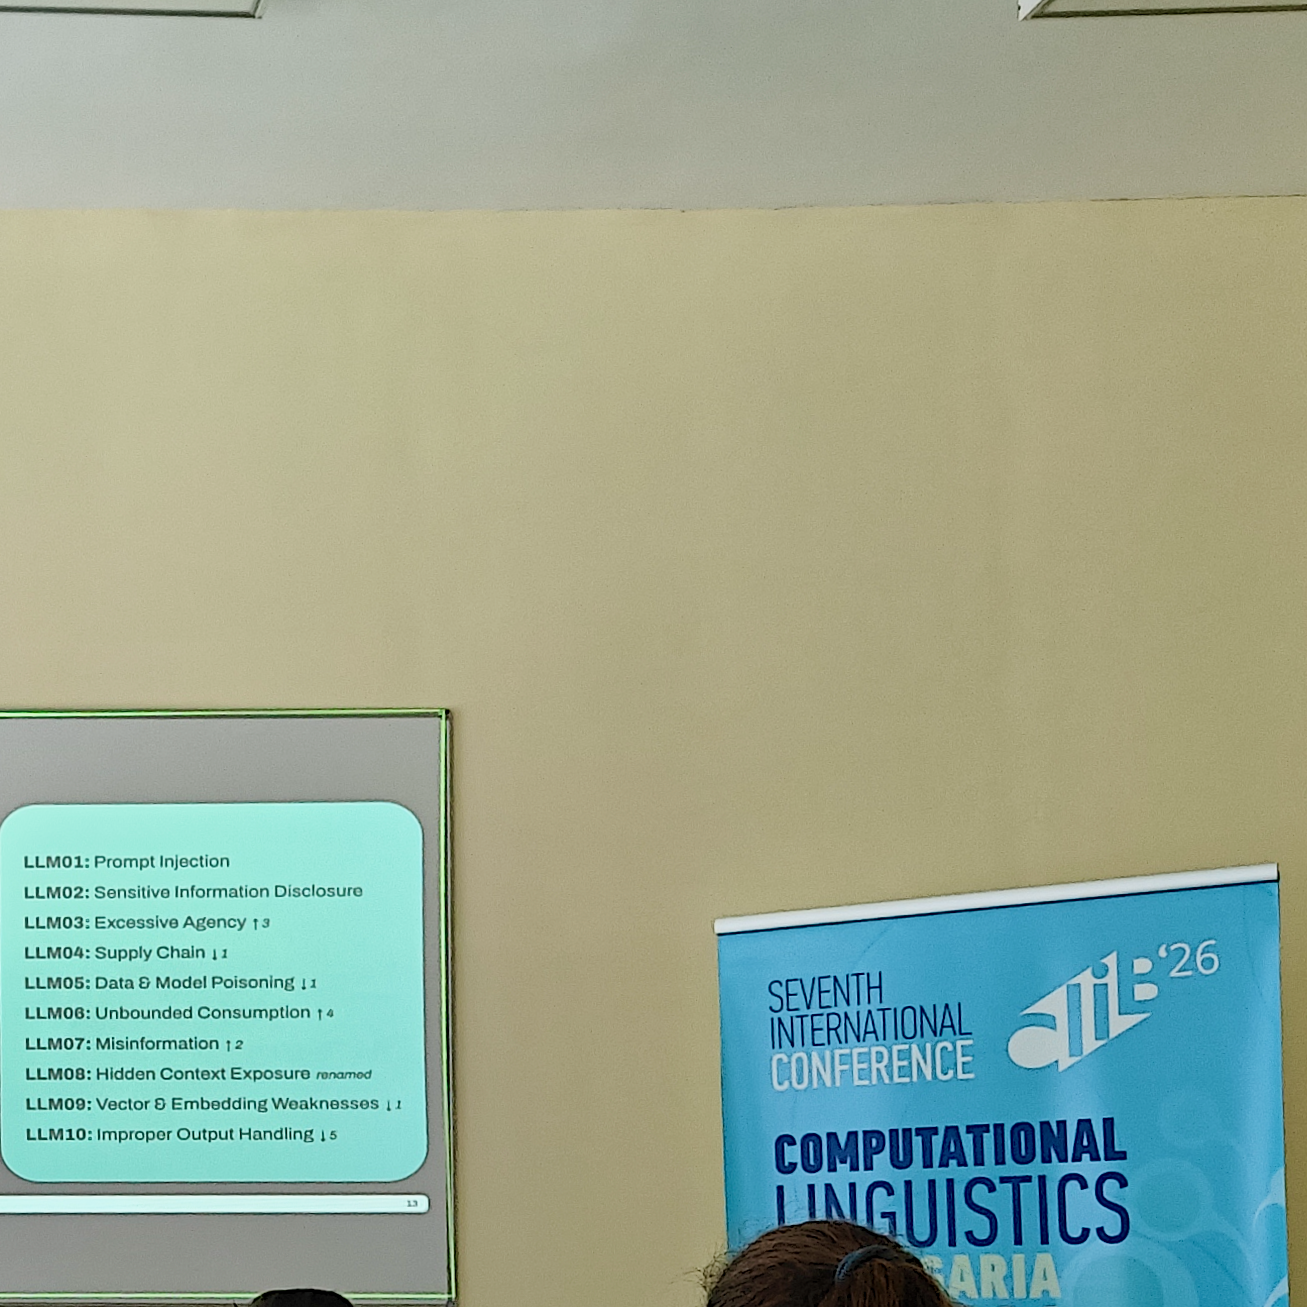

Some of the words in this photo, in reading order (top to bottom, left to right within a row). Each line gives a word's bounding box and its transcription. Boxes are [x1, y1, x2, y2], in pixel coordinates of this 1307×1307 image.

[24, 856, 90, 869] LLM01:
[94, 856, 156, 872] Prompt
[159, 854, 231, 871] Injection
[24, 886, 90, 900] LLM02:
[94, 885, 171, 899] Sensitive
[174, 885, 270, 899] Information
[274, 884, 364, 899] Disclosure
[24, 916, 91, 930] LLM03:
[94, 915, 179, 930] Excessive
[181, 916, 247, 932] Agency
[24, 946, 91, 960] LLM04:
[94, 946, 153, 963] Supply
[156, 945, 206, 960] Chain
[25, 977, 91, 990] LLM05:
[95, 976, 135, 990] Data
[138, 976, 152, 990] &
[155, 976, 208, 990] Model
[211, 975, 296, 992] Poisoning
[767, 971, 884, 1014] SEVENTH
[25, 1007, 91, 1021] LLM06:
[95, 1006, 194, 1021] Unbounded
[197, 1005, 311, 1022] Consumption
[769, 1001, 973, 1050] INTERNATIONAL
[25, 1037, 92, 1051] LLM07:
[95, 1036, 220, 1051] Misinformation
[771, 1040, 976, 1092] CONFERENCE
[25, 1067, 92, 1081] LLM08:
[95, 1067, 157, 1081] Hidden
[160, 1067, 227, 1081] Context
[230, 1067, 311, 1083] Exposure
[316, 1069, 373, 1081] renamed
[26, 1098, 92, 1112] LLM09:
[95, 1098, 151, 1112] Vector
[154, 1098, 167, 1112] &
[171, 1097, 269, 1114] Embedding
[271, 1097, 380, 1111] Weaknesses
[26, 1128, 93, 1142] LLM10:
[96, 1127, 173, 1144] Improper
[176, 1127, 235, 1144] Output
[238, 1127, 315, 1143] Handling
[774, 1117, 1128, 1175] COMPUTATIONAL
